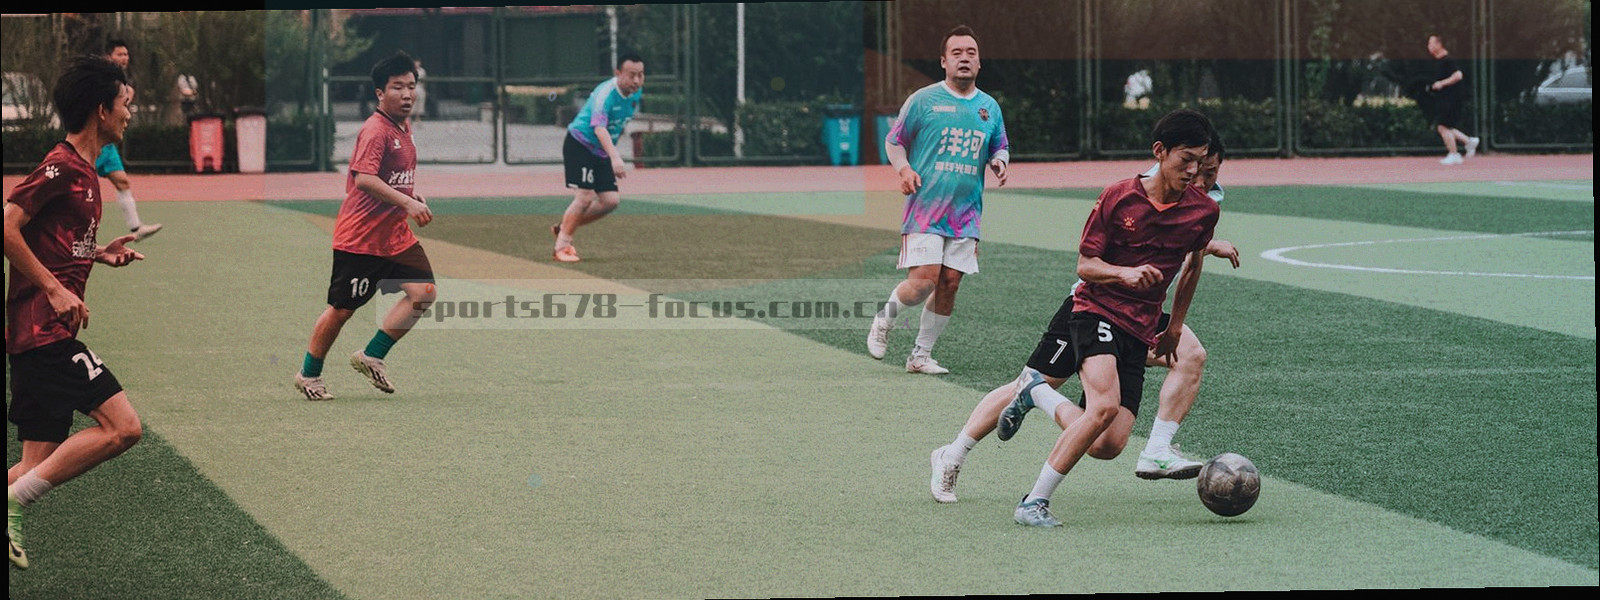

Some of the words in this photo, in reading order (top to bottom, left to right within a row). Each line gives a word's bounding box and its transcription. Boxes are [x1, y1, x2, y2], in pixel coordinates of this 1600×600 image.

[938, 127, 986, 160] 洋河
[582, 167, 594, 183] 16
[350, 277, 370, 298] 10
[1097, 320, 1114, 342] 5
[1049, 338, 1068, 365] 7
